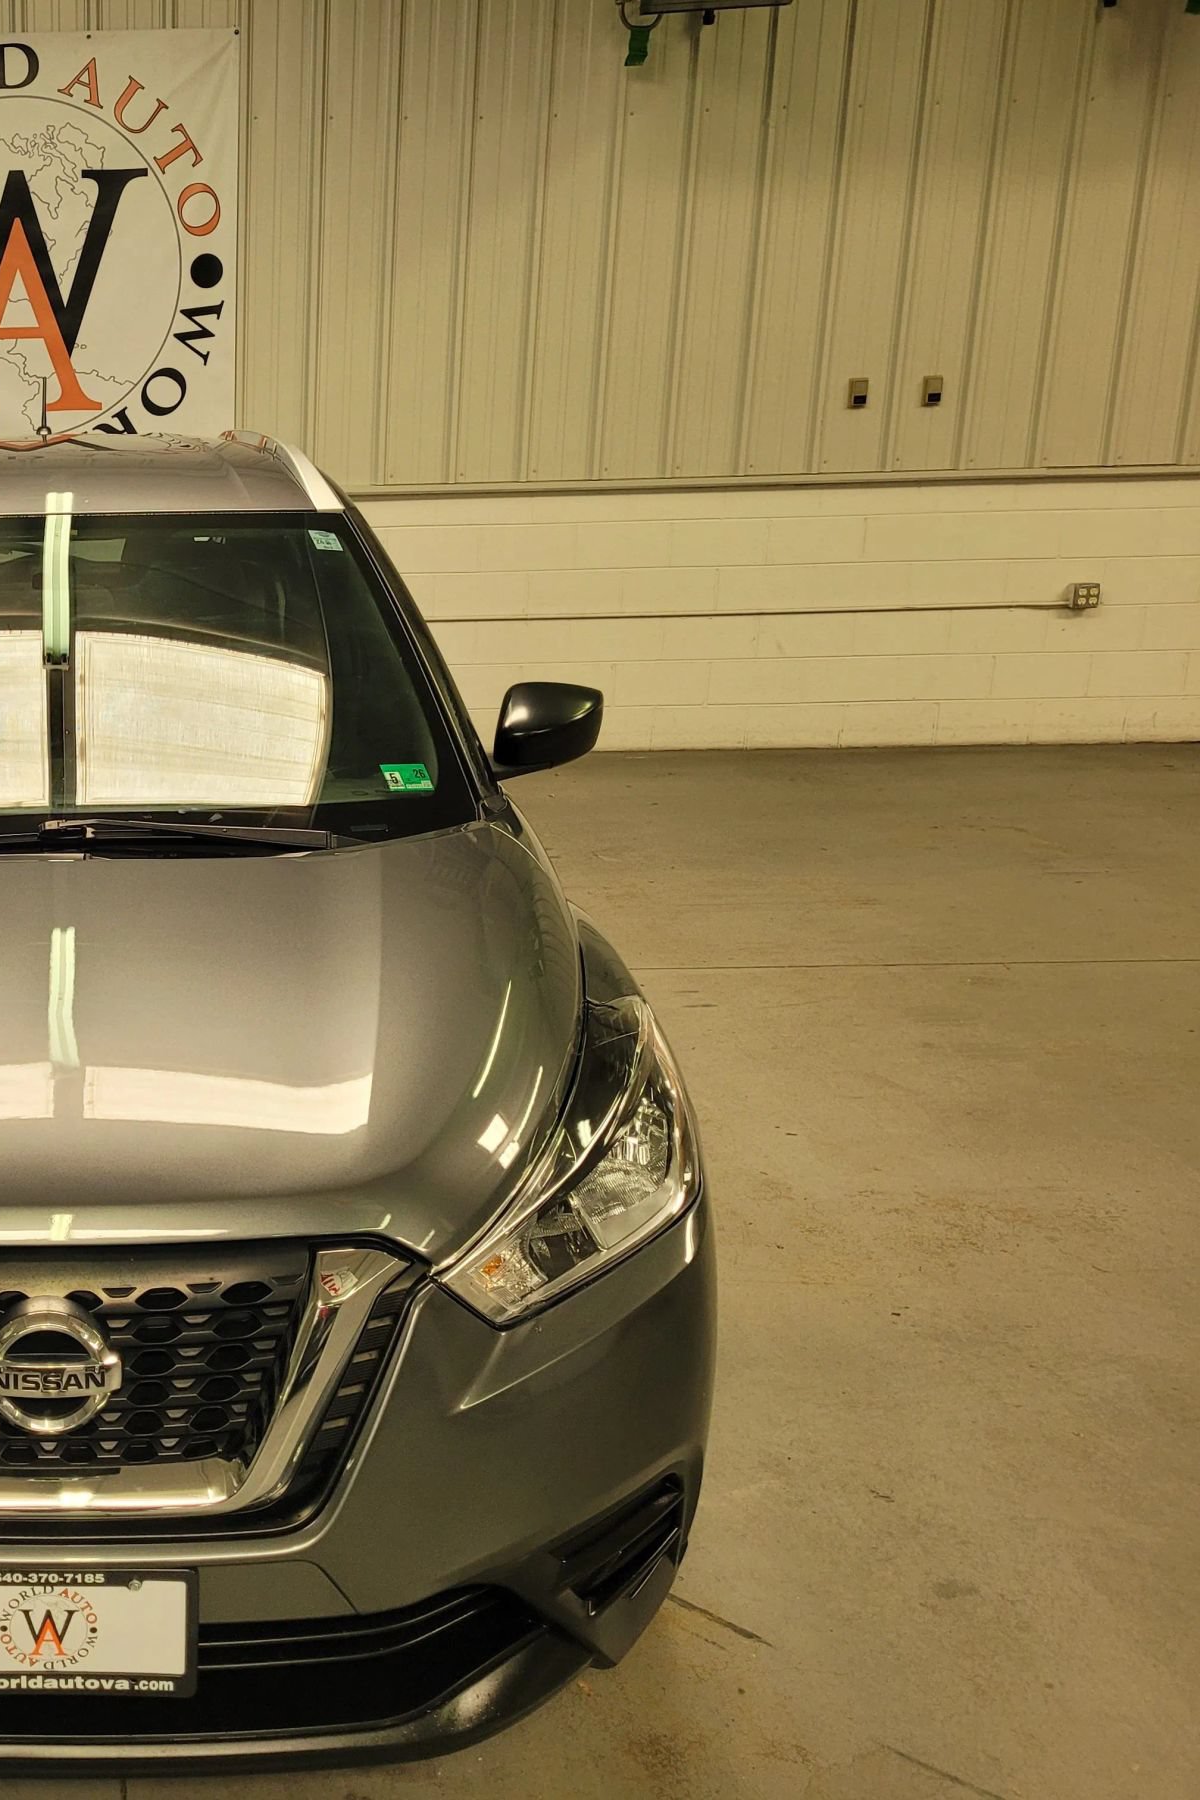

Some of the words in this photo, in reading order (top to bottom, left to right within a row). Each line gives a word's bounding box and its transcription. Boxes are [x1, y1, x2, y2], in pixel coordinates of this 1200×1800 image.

[57, 57, 222, 237] AUTO
[0, 1585, 55, 1622] WORLD
[58, 1587, 98, 1624] AUTO
[0, 1634, 39, 1668] AUTO
[43, 1635, 98, 1670] WORLD
